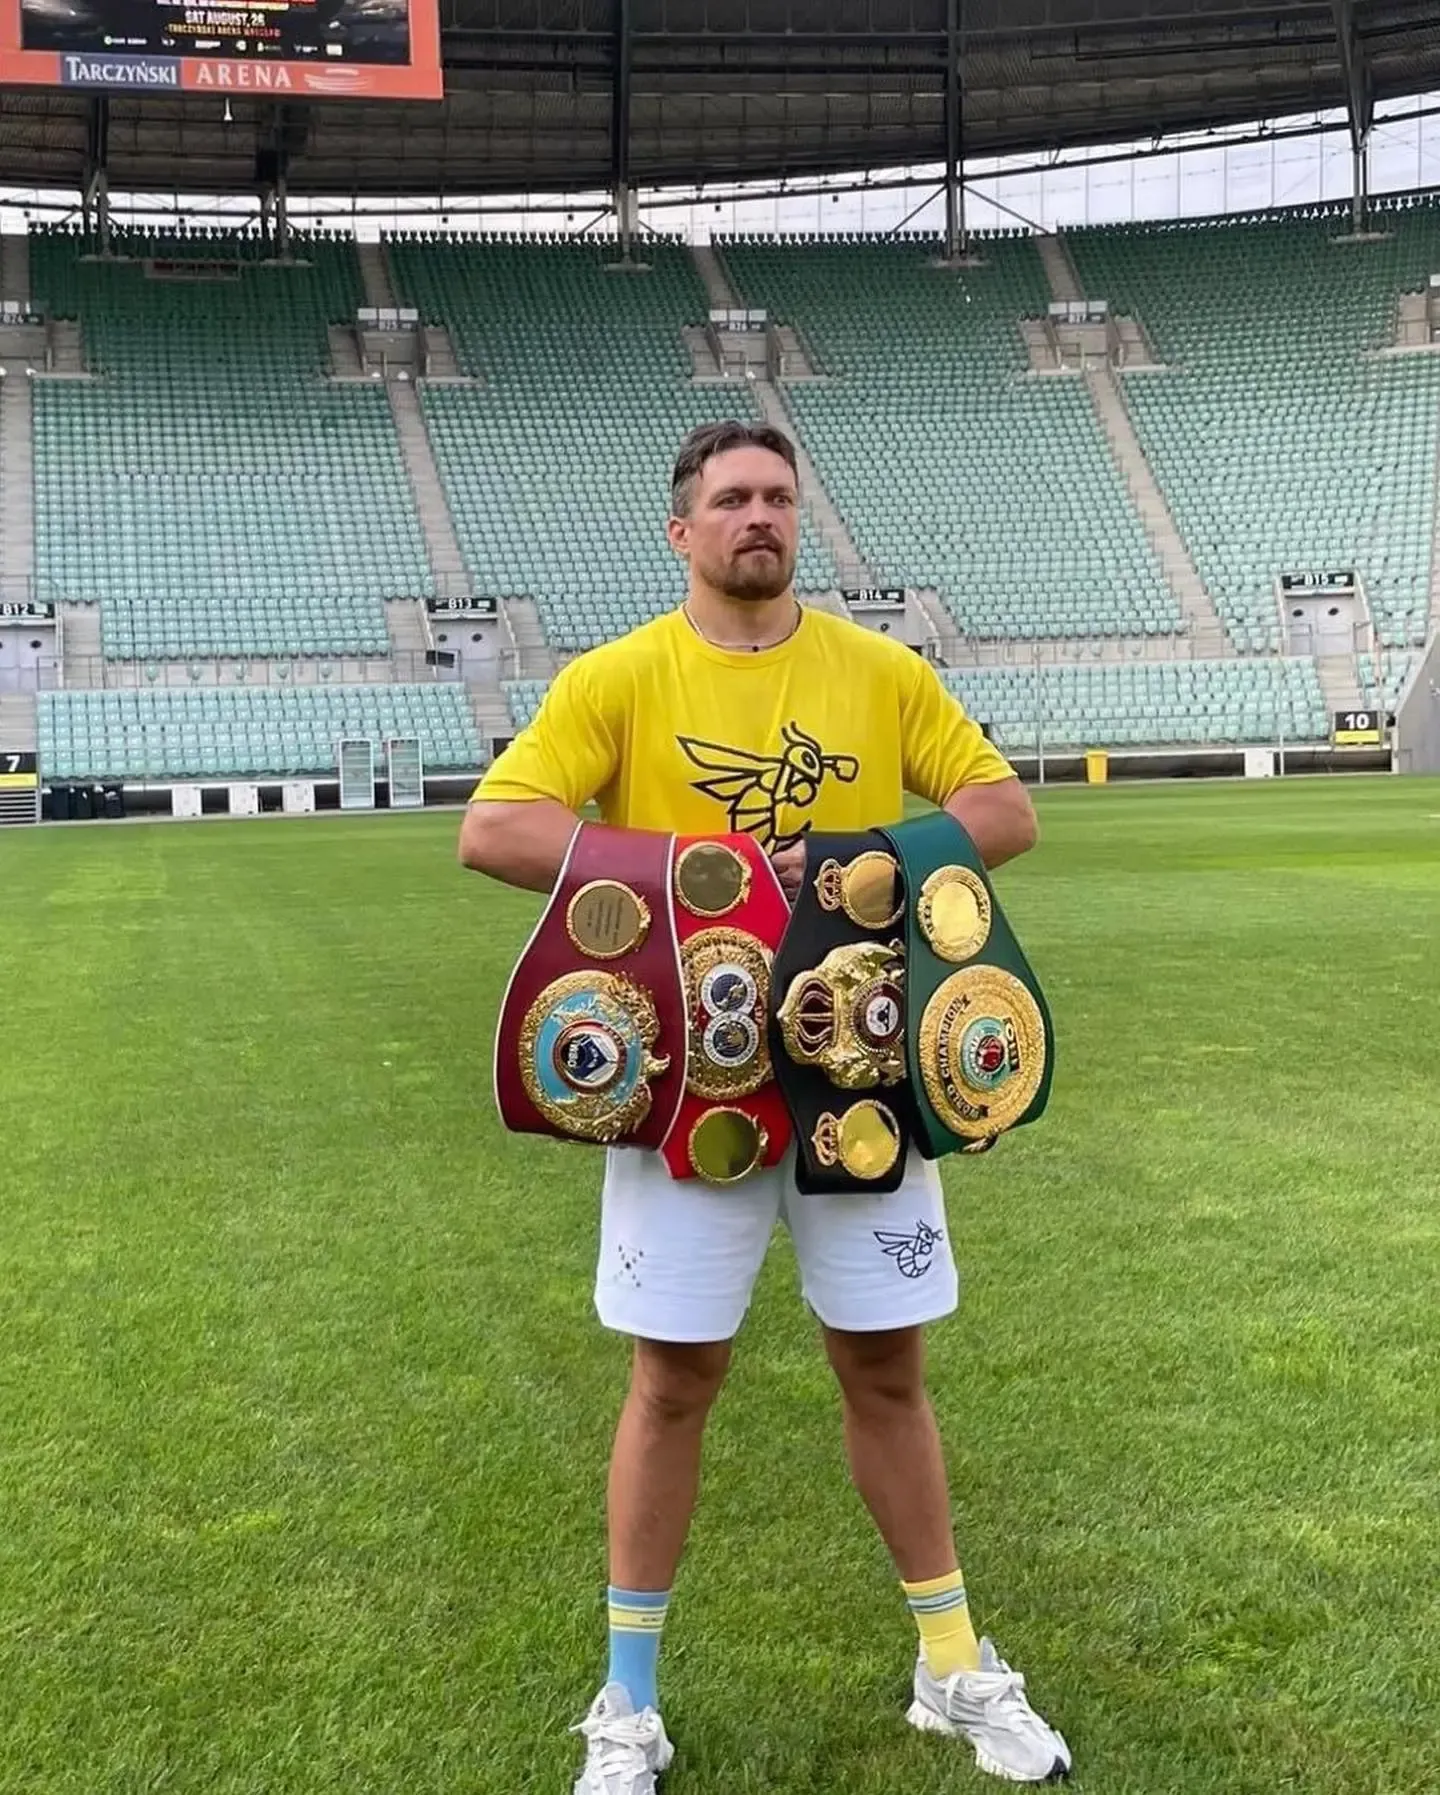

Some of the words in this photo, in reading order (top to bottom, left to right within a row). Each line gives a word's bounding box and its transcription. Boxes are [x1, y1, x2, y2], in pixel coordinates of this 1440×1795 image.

[184, 10, 206, 24] SAT
[65, 56, 177, 85] TARCZYŃSKI
[196, 63, 292, 88] ARENA
[860, 589, 882, 600] B14
[3, 602, 29, 616] B12
[449, 598, 472, 609] B13
[1344, 713, 1370, 730] 10
[6, 755, 20, 772] 7
[938, 996, 966, 1079] CHAMPION
[946, 1083, 981, 1119] WORLD
